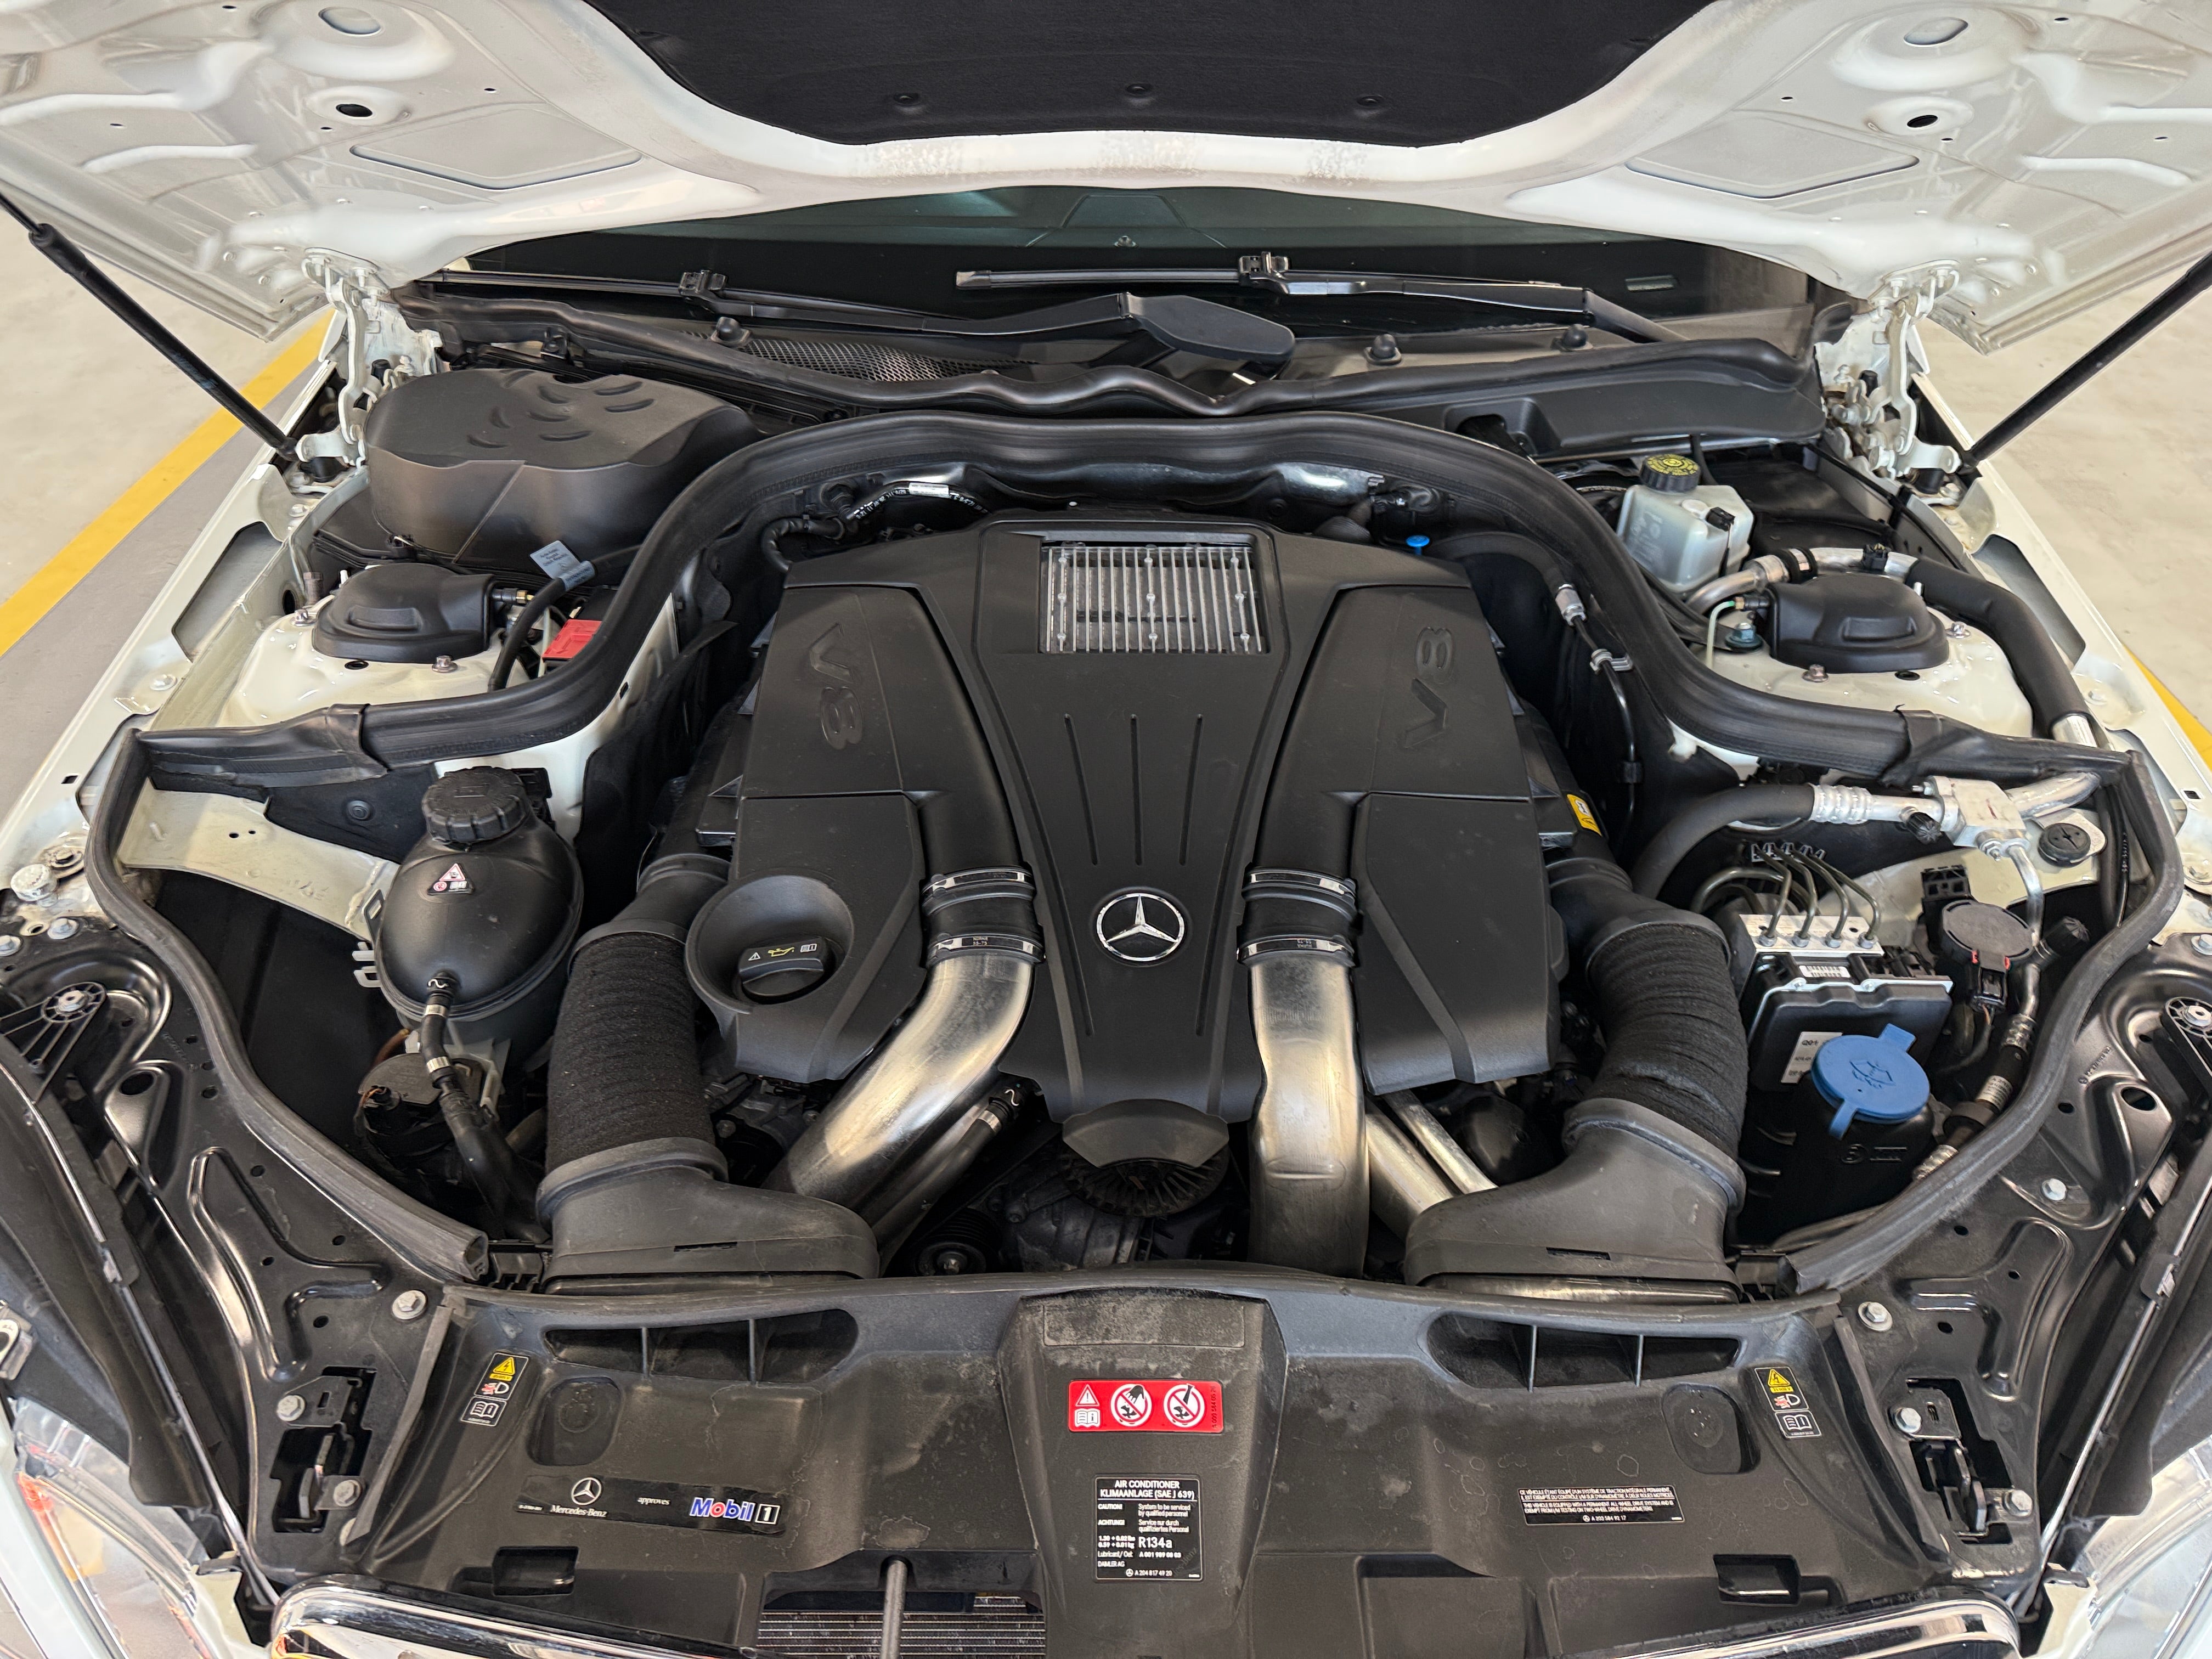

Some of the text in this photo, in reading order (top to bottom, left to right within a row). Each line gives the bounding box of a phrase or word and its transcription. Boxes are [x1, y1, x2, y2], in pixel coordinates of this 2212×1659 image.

[809, 622, 864, 751] V8
[1404, 626, 1454, 748] V8
[1114, 1480, 1180, 1489] AIR CONDITIONER
[1100, 1489, 1154, 1498] KLIMAANLAGE
[1154, 1490, 1170, 1499] (SAE
[1177, 1490, 1195, 1500] 639)
[637, 1496, 670, 1506] approves
[550, 1505, 607, 1517] Mercedes-Benz
[689, 1497, 755, 1522] Mobil
[1138, 1537, 1172, 1548] R134a
